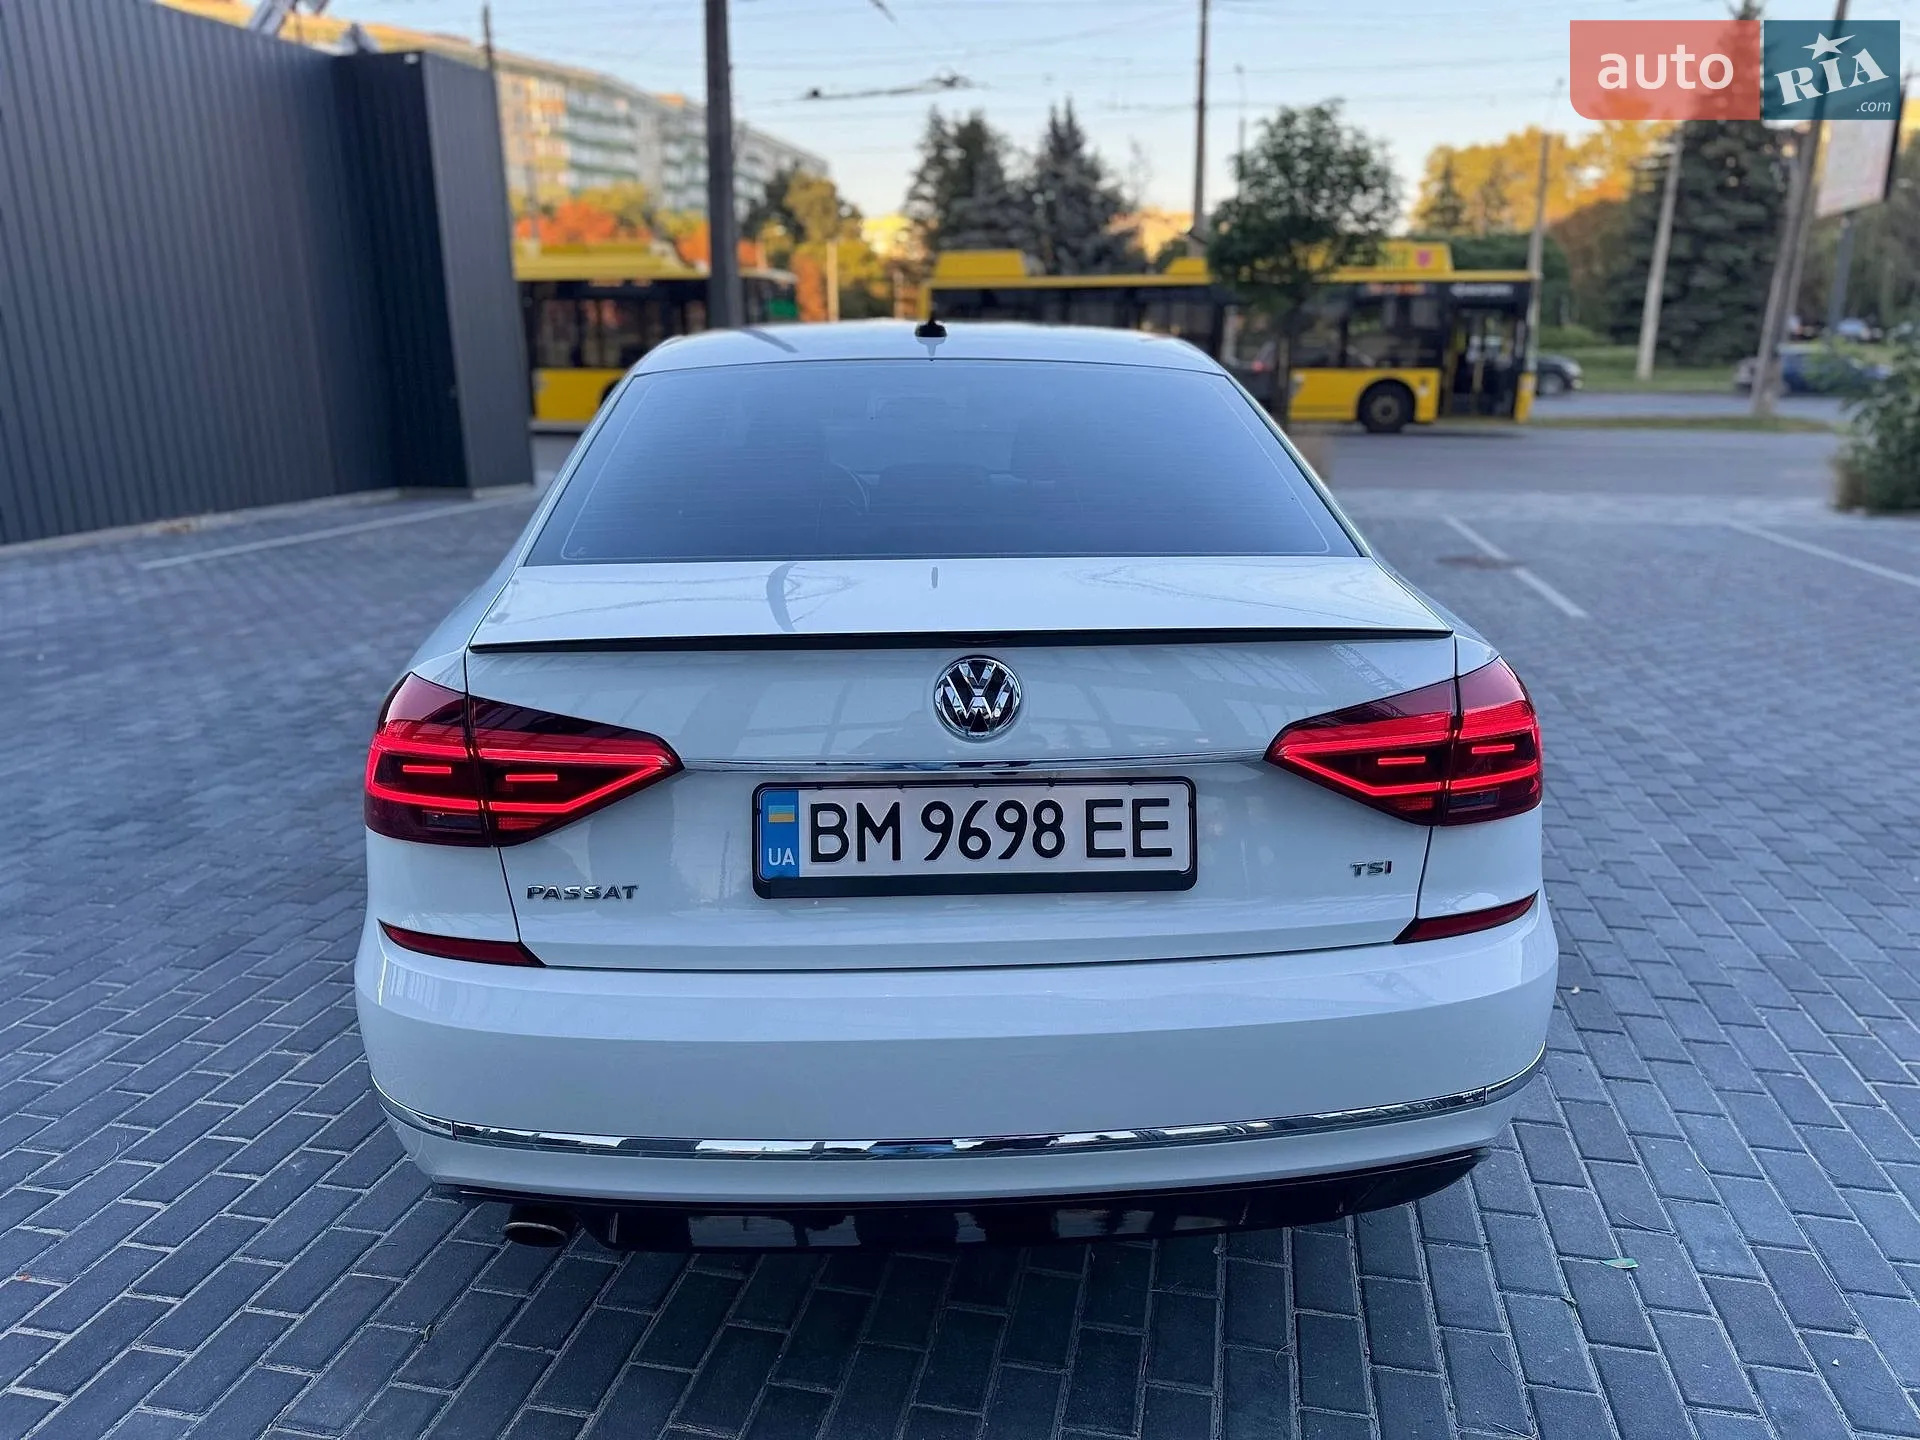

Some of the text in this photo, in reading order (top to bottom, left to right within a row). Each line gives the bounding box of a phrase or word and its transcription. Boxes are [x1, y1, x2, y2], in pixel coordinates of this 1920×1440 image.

[809, 798, 1173, 863] BM 9698 EE
[768, 847, 796, 866] UA
[1350, 861, 1392, 877] TSI
[527, 885, 639, 900] PASSAT
